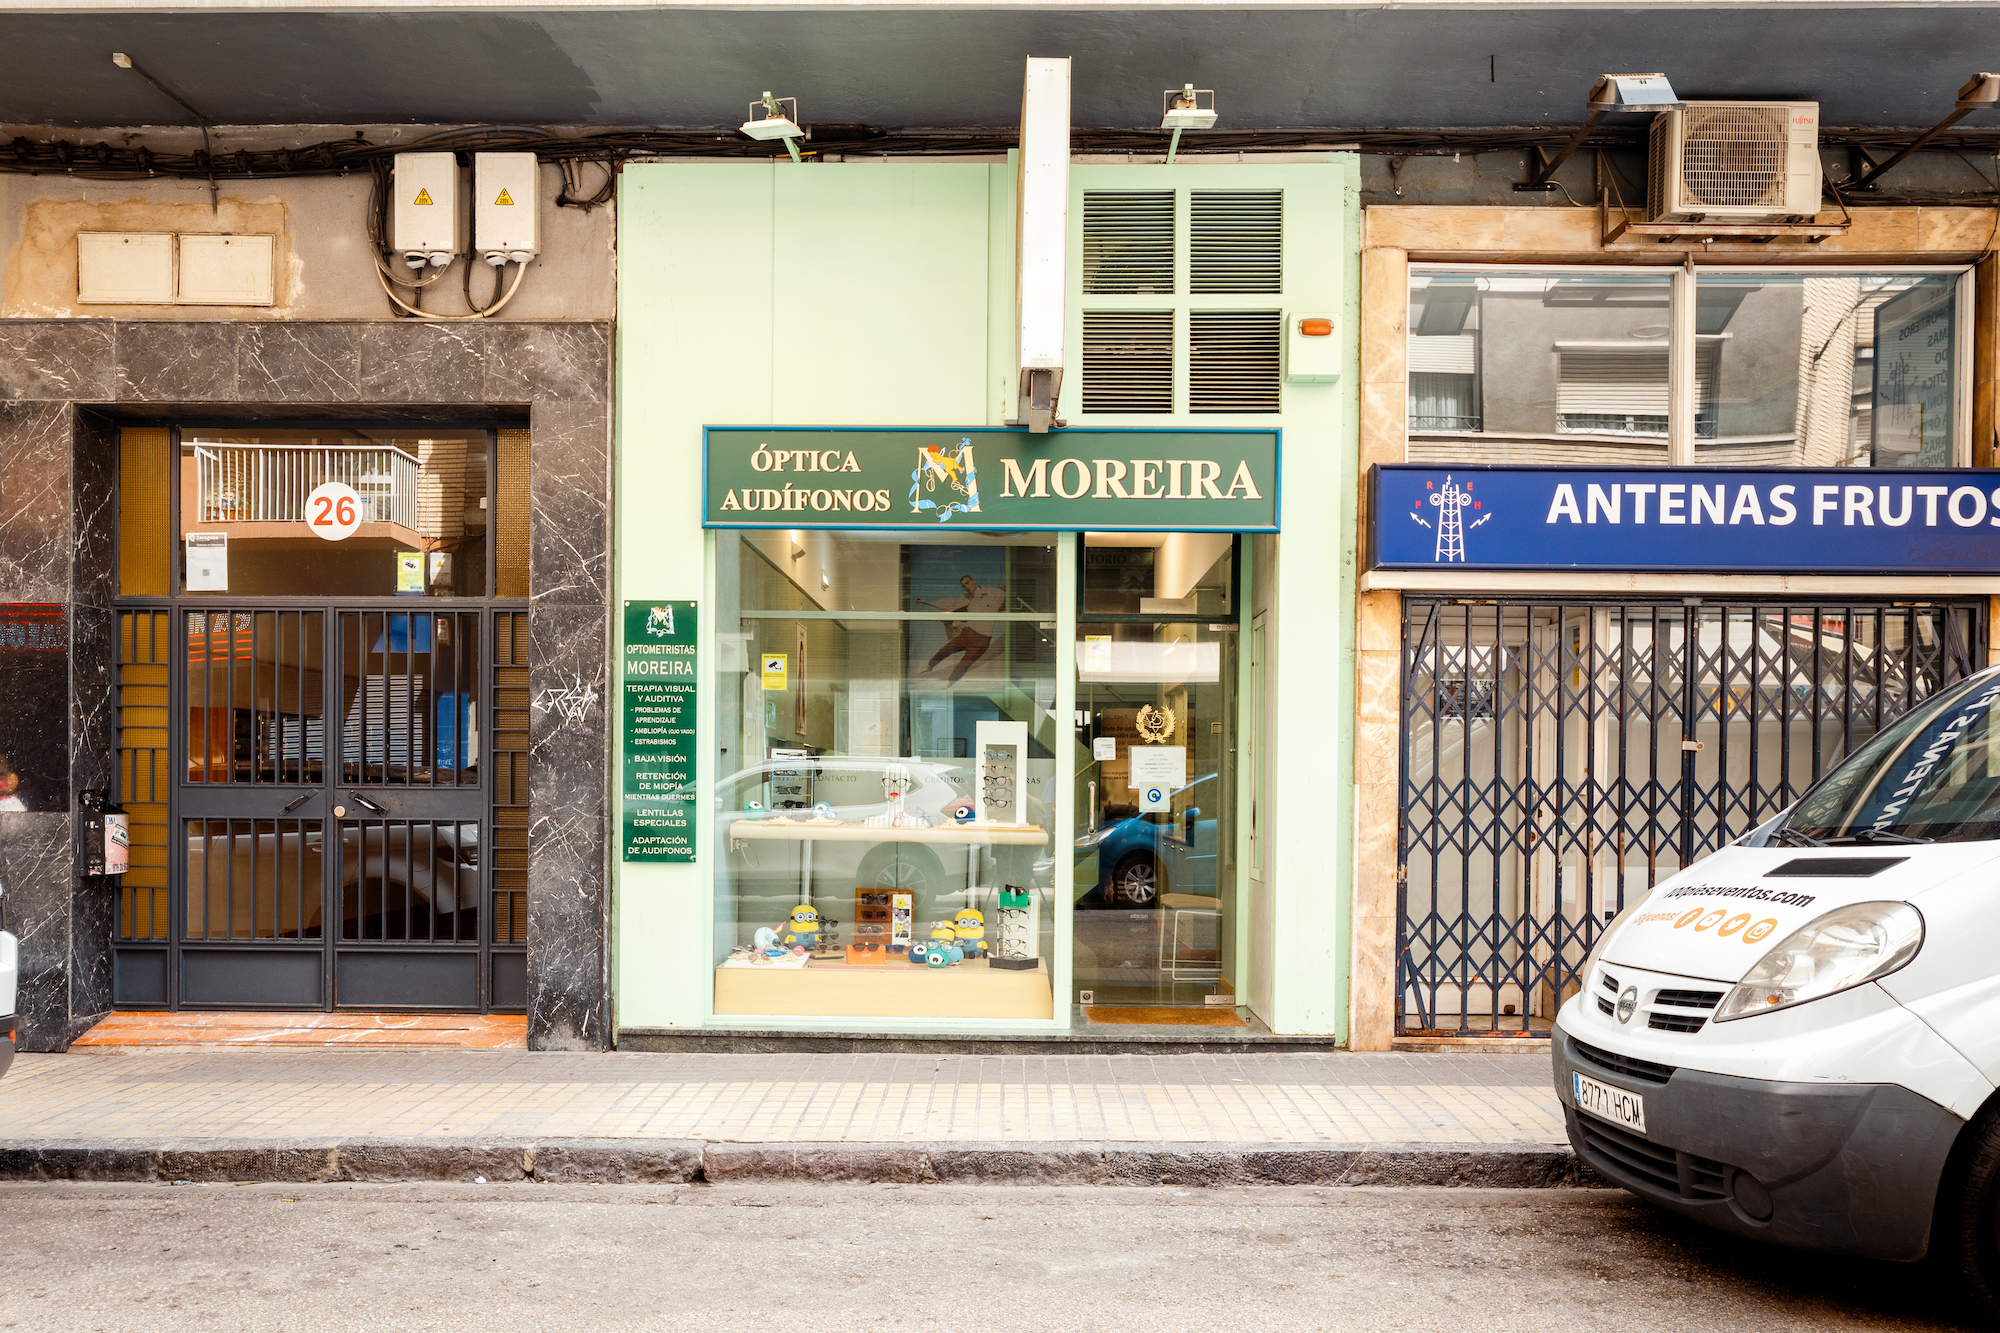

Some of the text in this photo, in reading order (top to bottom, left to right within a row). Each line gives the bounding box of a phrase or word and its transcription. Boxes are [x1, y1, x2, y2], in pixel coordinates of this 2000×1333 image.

[1792, 115, 1814, 125] FUJITSU
[751, 443, 862, 473] ÓPTICA
[1000, 458, 1264, 499] MOREIRA
[720, 483, 893, 512] AUDÍFONOS
[1546, 483, 2000, 528] ANTENAS FRUTO
[313, 496, 356, 526] 26
[626, 644, 696, 655] OPTOMETRISTAS
[627, 660, 694, 675] MOREIRA
[626, 685, 696, 693] TERAPIA VISUAL
[637, 695, 684, 703] Y AUDITIVA
[634, 706, 672, 714] PROBLEMAS
[634, 716, 677, 724] APRENDIZAJE
[634, 726, 668, 735] AMBLIOPÍA
[634, 753, 687, 763] BAJA VISIÓN
[635, 771, 687, 780] RETENCIÓN
[639, 781, 684, 790] DE MIOPÍA
[636, 809, 684, 817] LENTILLAS
[633, 819, 687, 827] ESPECIALES
[632, 835, 688, 845] ADAPTACIÓN
[627, 847, 693, 855] DE AUDIFONOS
[1582, 1079, 1641, 1126] 8771 HCM
